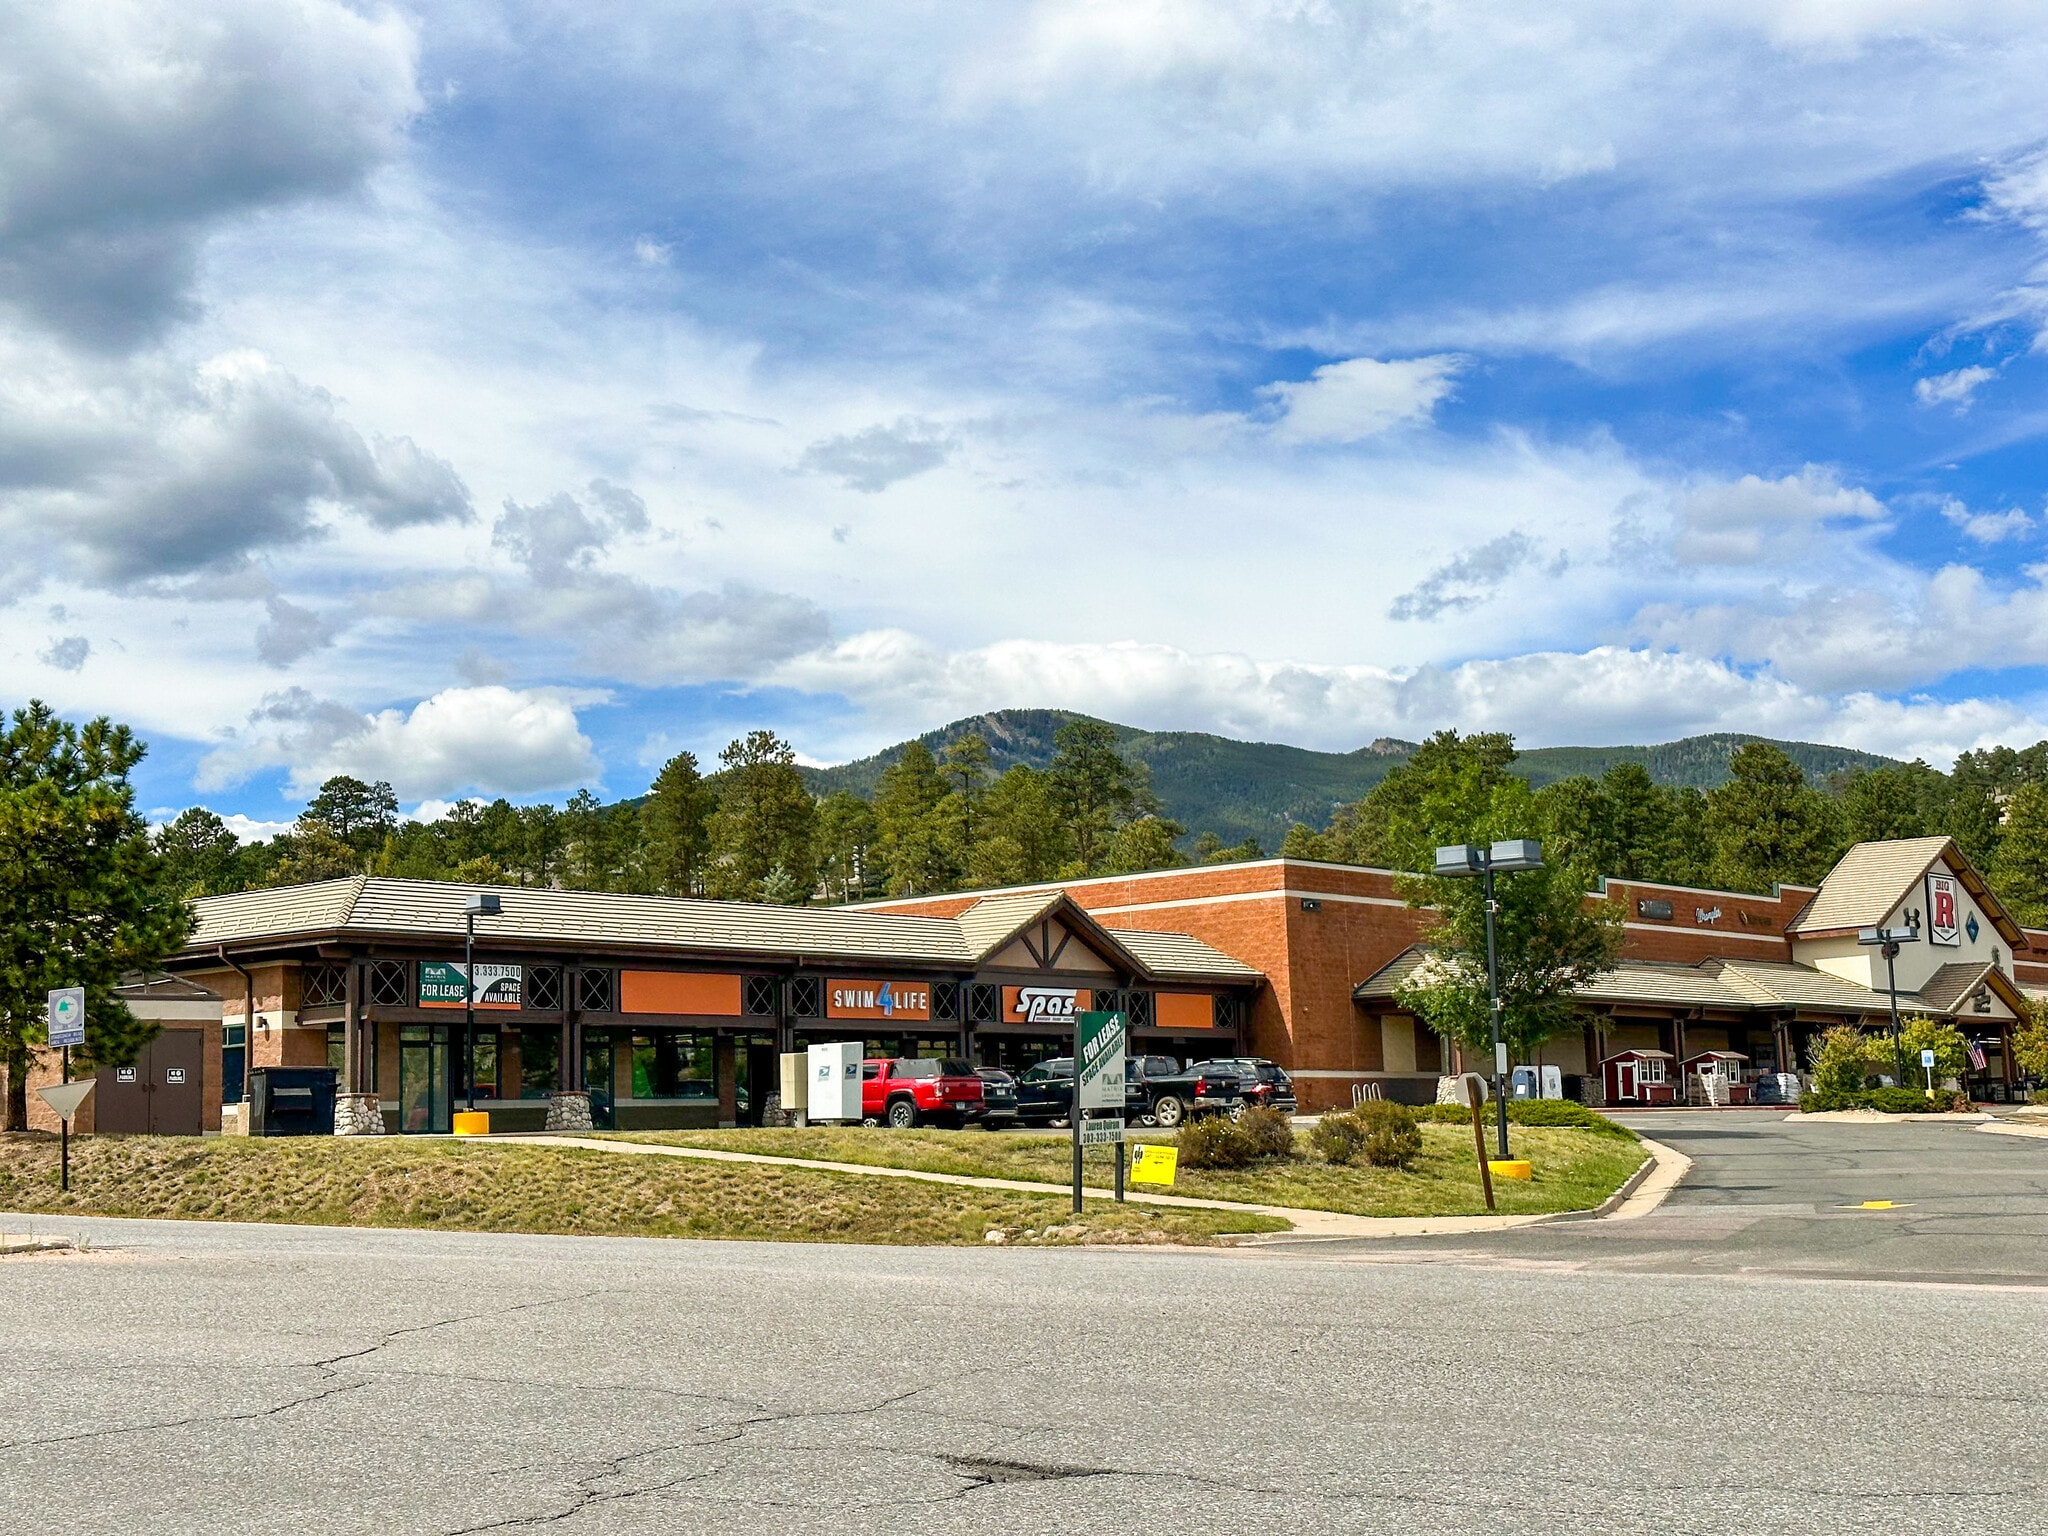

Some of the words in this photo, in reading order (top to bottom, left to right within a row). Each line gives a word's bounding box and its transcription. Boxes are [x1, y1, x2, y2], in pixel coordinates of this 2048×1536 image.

[1935, 880, 1950, 891] BIG
[1934, 892, 1955, 929] R
[463, 965, 521, 978] 33.333.7500
[421, 984, 438, 996] FOR
[439, 984, 465, 997] LEASE
[484, 992, 521, 1003] AVAILABLE
[500, 982, 521, 992] SPACE
[834, 990, 874, 1008] SWIM
[875, 982, 893, 1016] 4
[894, 991, 927, 1009] LIFE
[1016, 987, 1077, 1022] Spas
[1082, 1037, 1099, 1064] FOR
[1098, 1013, 1120, 1048] LEASE
[1081, 1061, 1099, 1086] SPACE
[1099, 1034, 1124, 1069] AVAILABLE
